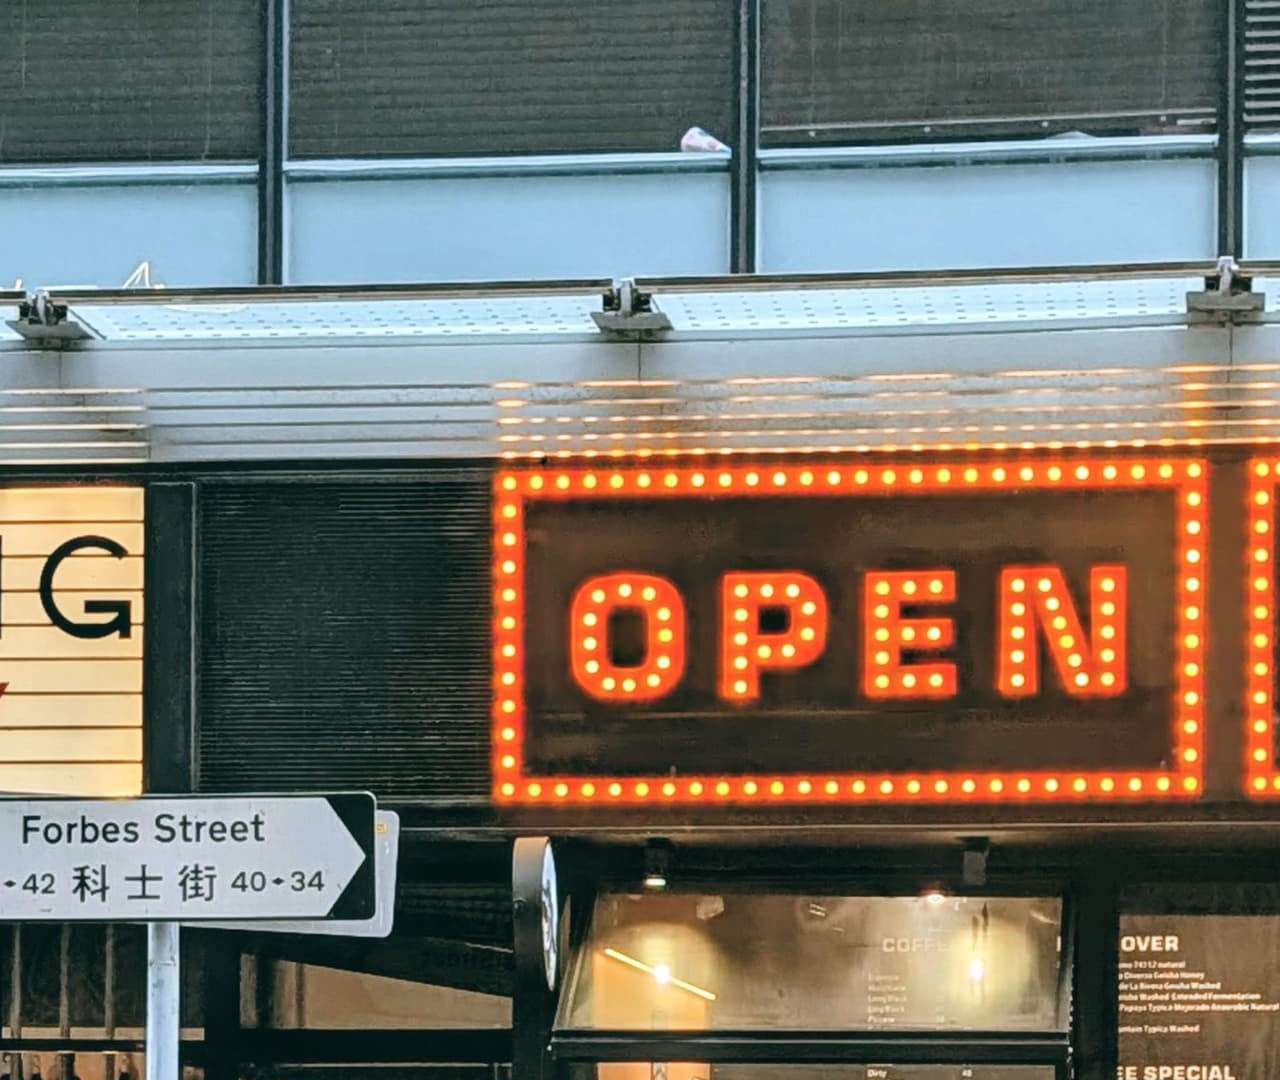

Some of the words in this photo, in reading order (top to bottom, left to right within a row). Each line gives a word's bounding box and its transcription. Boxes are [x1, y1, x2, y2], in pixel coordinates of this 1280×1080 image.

[570, 565, 1126, 704] OPEN
[22, 814, 140, 845] Forbes
[154, 812, 265, 843] Street
[72, 863, 216, 903] 科士街
[883, 938, 961, 953] COFFE
[1120, 935, 1179, 952] OVER
